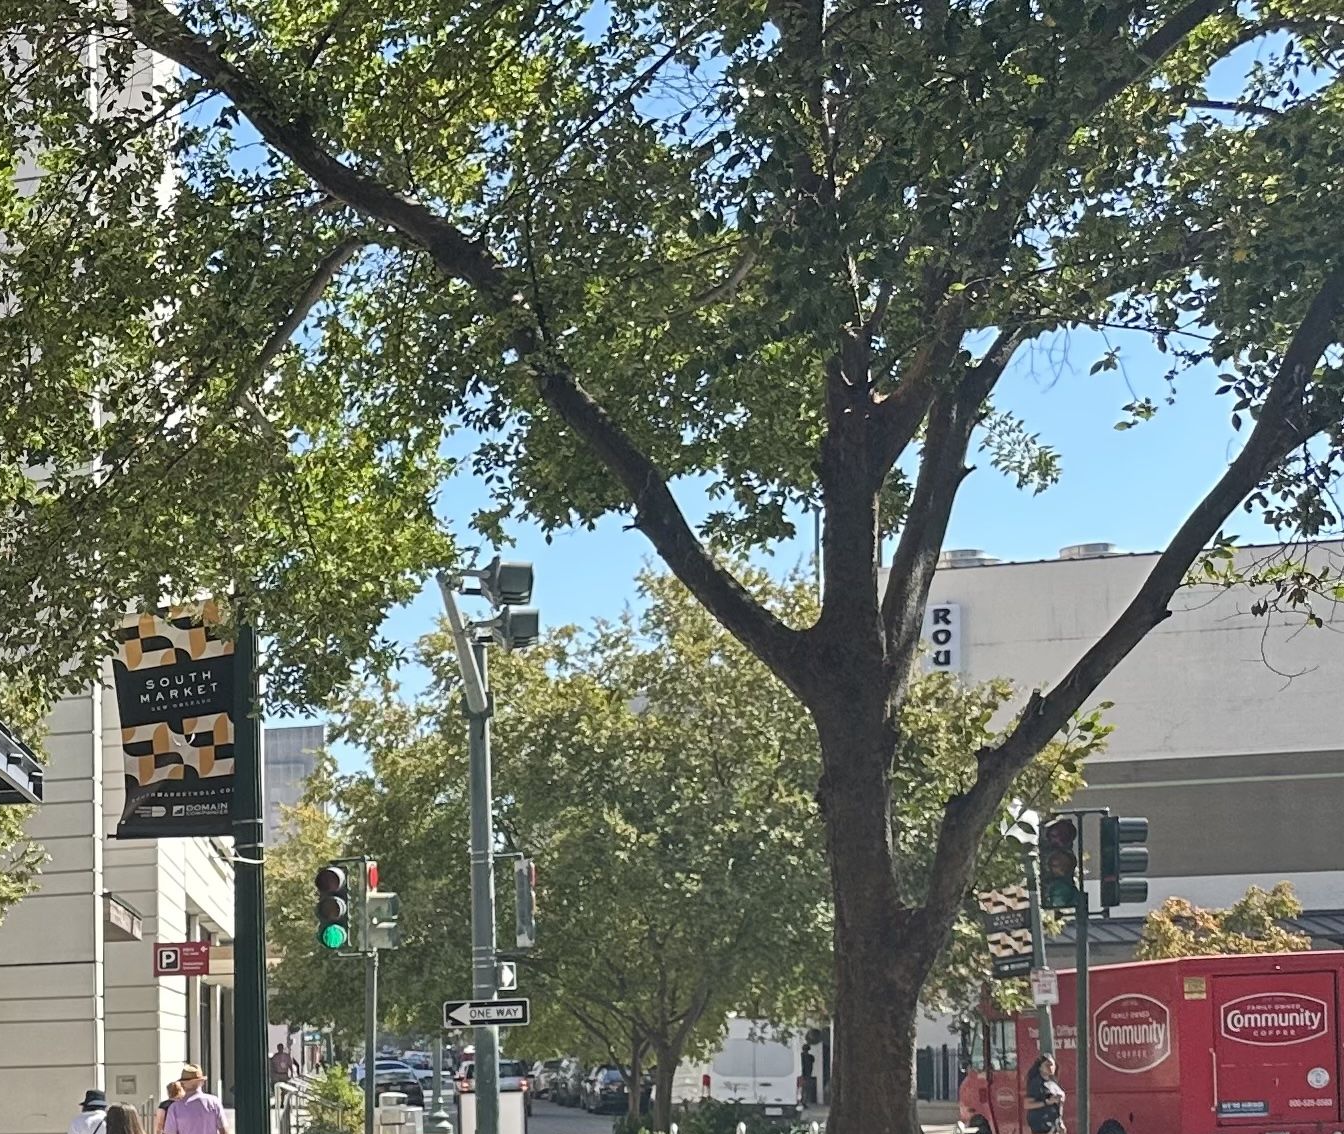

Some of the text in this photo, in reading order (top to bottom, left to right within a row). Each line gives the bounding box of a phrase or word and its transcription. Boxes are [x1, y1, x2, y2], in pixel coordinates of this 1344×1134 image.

[932, 608, 952, 673] ROU
[146, 670, 211, 690] SOUTH
[140, 682, 218, 704] MARKET
[185, 802, 228, 812] DOMAIN
[162, 951, 176, 968] P
[470, 1008, 519, 1019] ONE WAY
[1226, 1007, 1321, 1032] Community
[1098, 1017, 1165, 1052] Community
[1253, 1029, 1296, 1037] COFFEE
[1116, 1050, 1148, 1059] COFFEE
